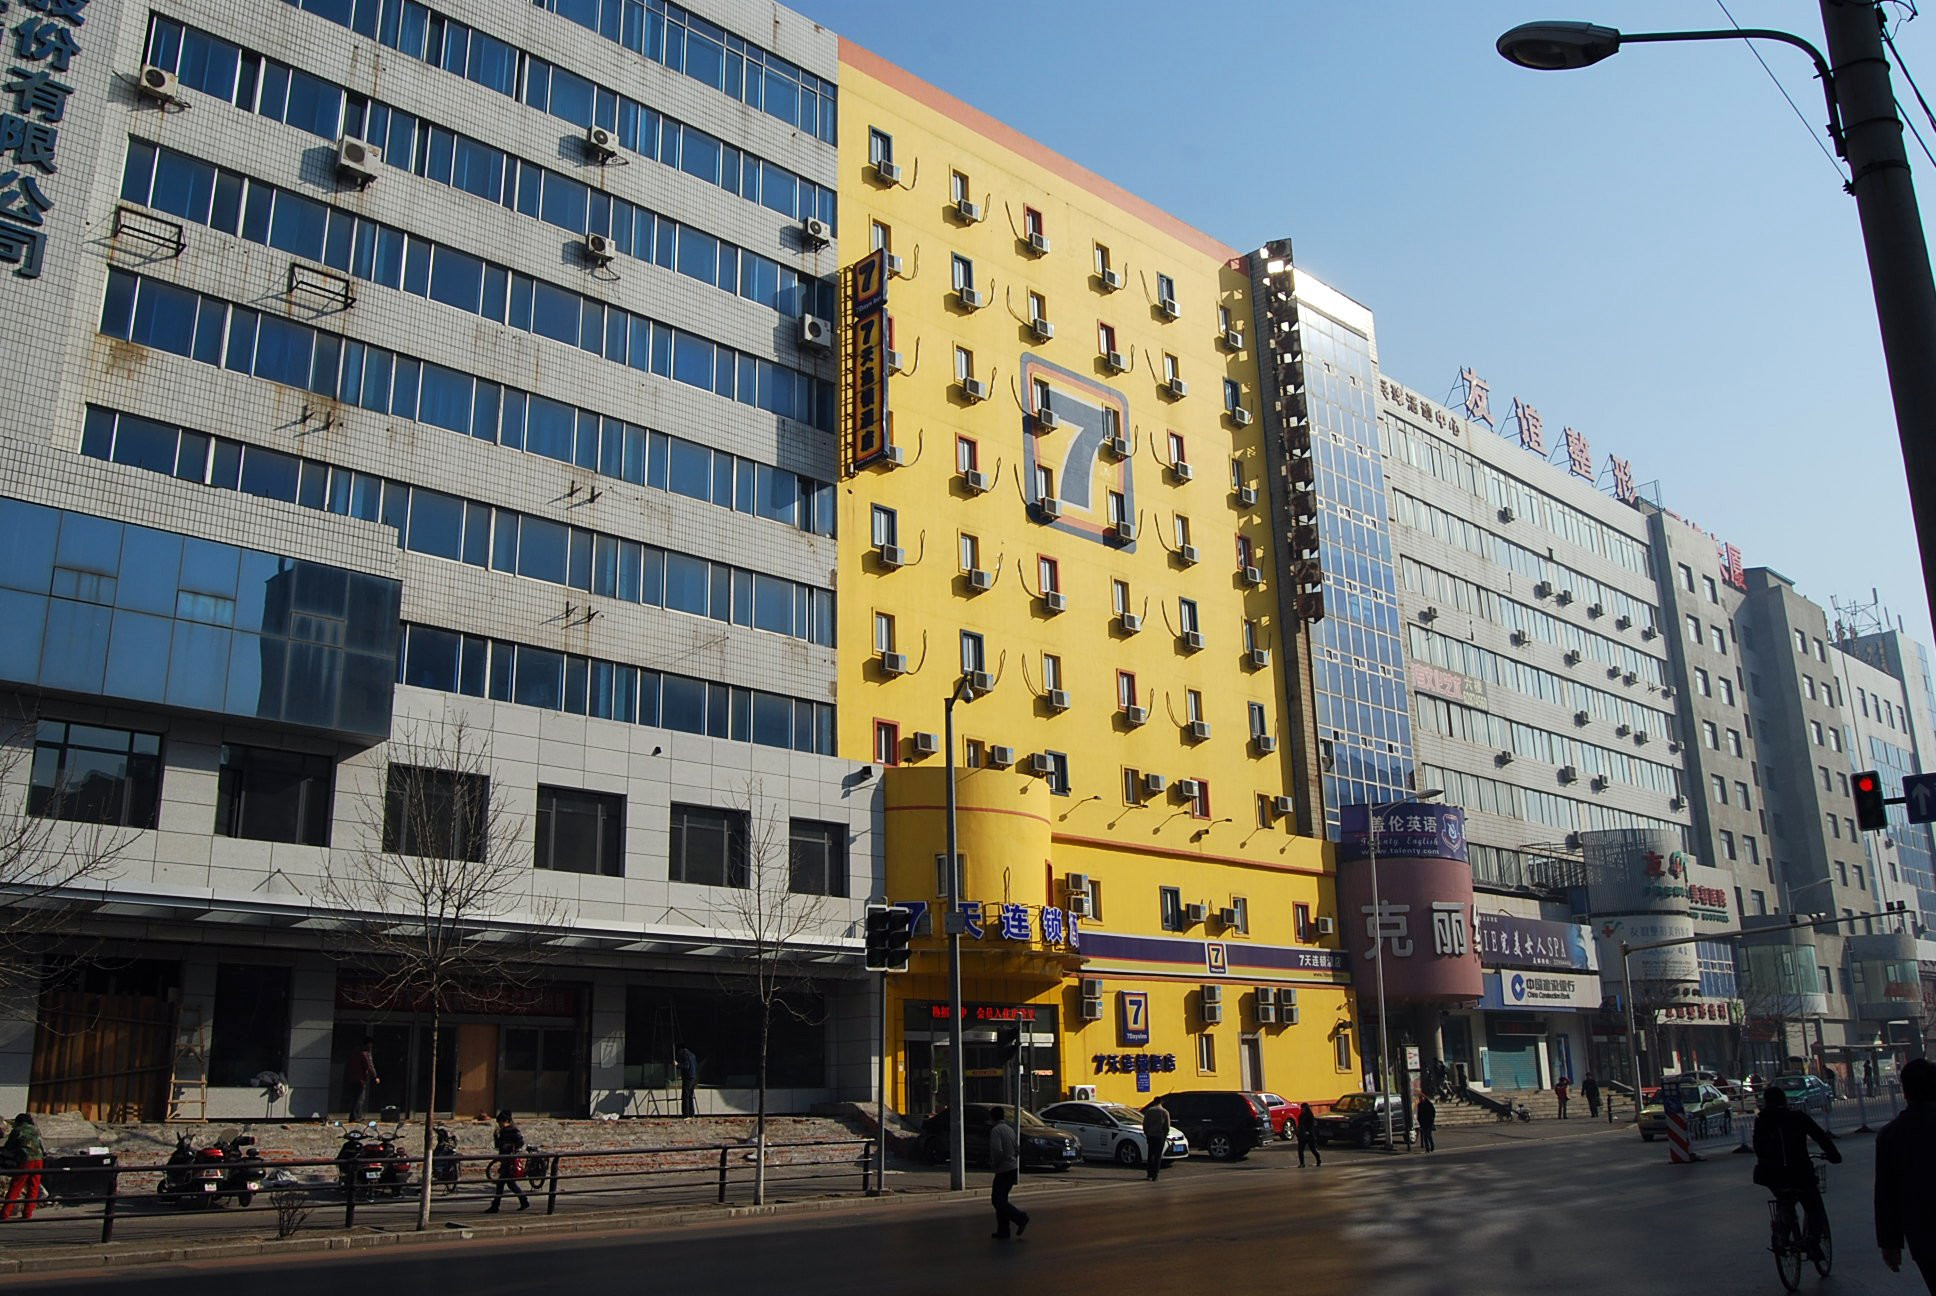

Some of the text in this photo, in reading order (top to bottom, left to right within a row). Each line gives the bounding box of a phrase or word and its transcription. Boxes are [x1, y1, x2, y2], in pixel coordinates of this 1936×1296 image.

[859, 259, 876, 293] 7
[1459, 366, 1638, 505] 友谊整形
[1044, 385, 1107, 513] 7
[1371, 815, 1438, 833] 盖伦英语
[1210, 947, 1221, 964] 7
[1298, 954, 1342, 967] 7天连锁酒店
[1526, 978, 1575, 992] 中国建设银行
[1128, 999, 1143, 1025] 7
[1091, 1053, 1177, 1075] 7天连锁酒店
